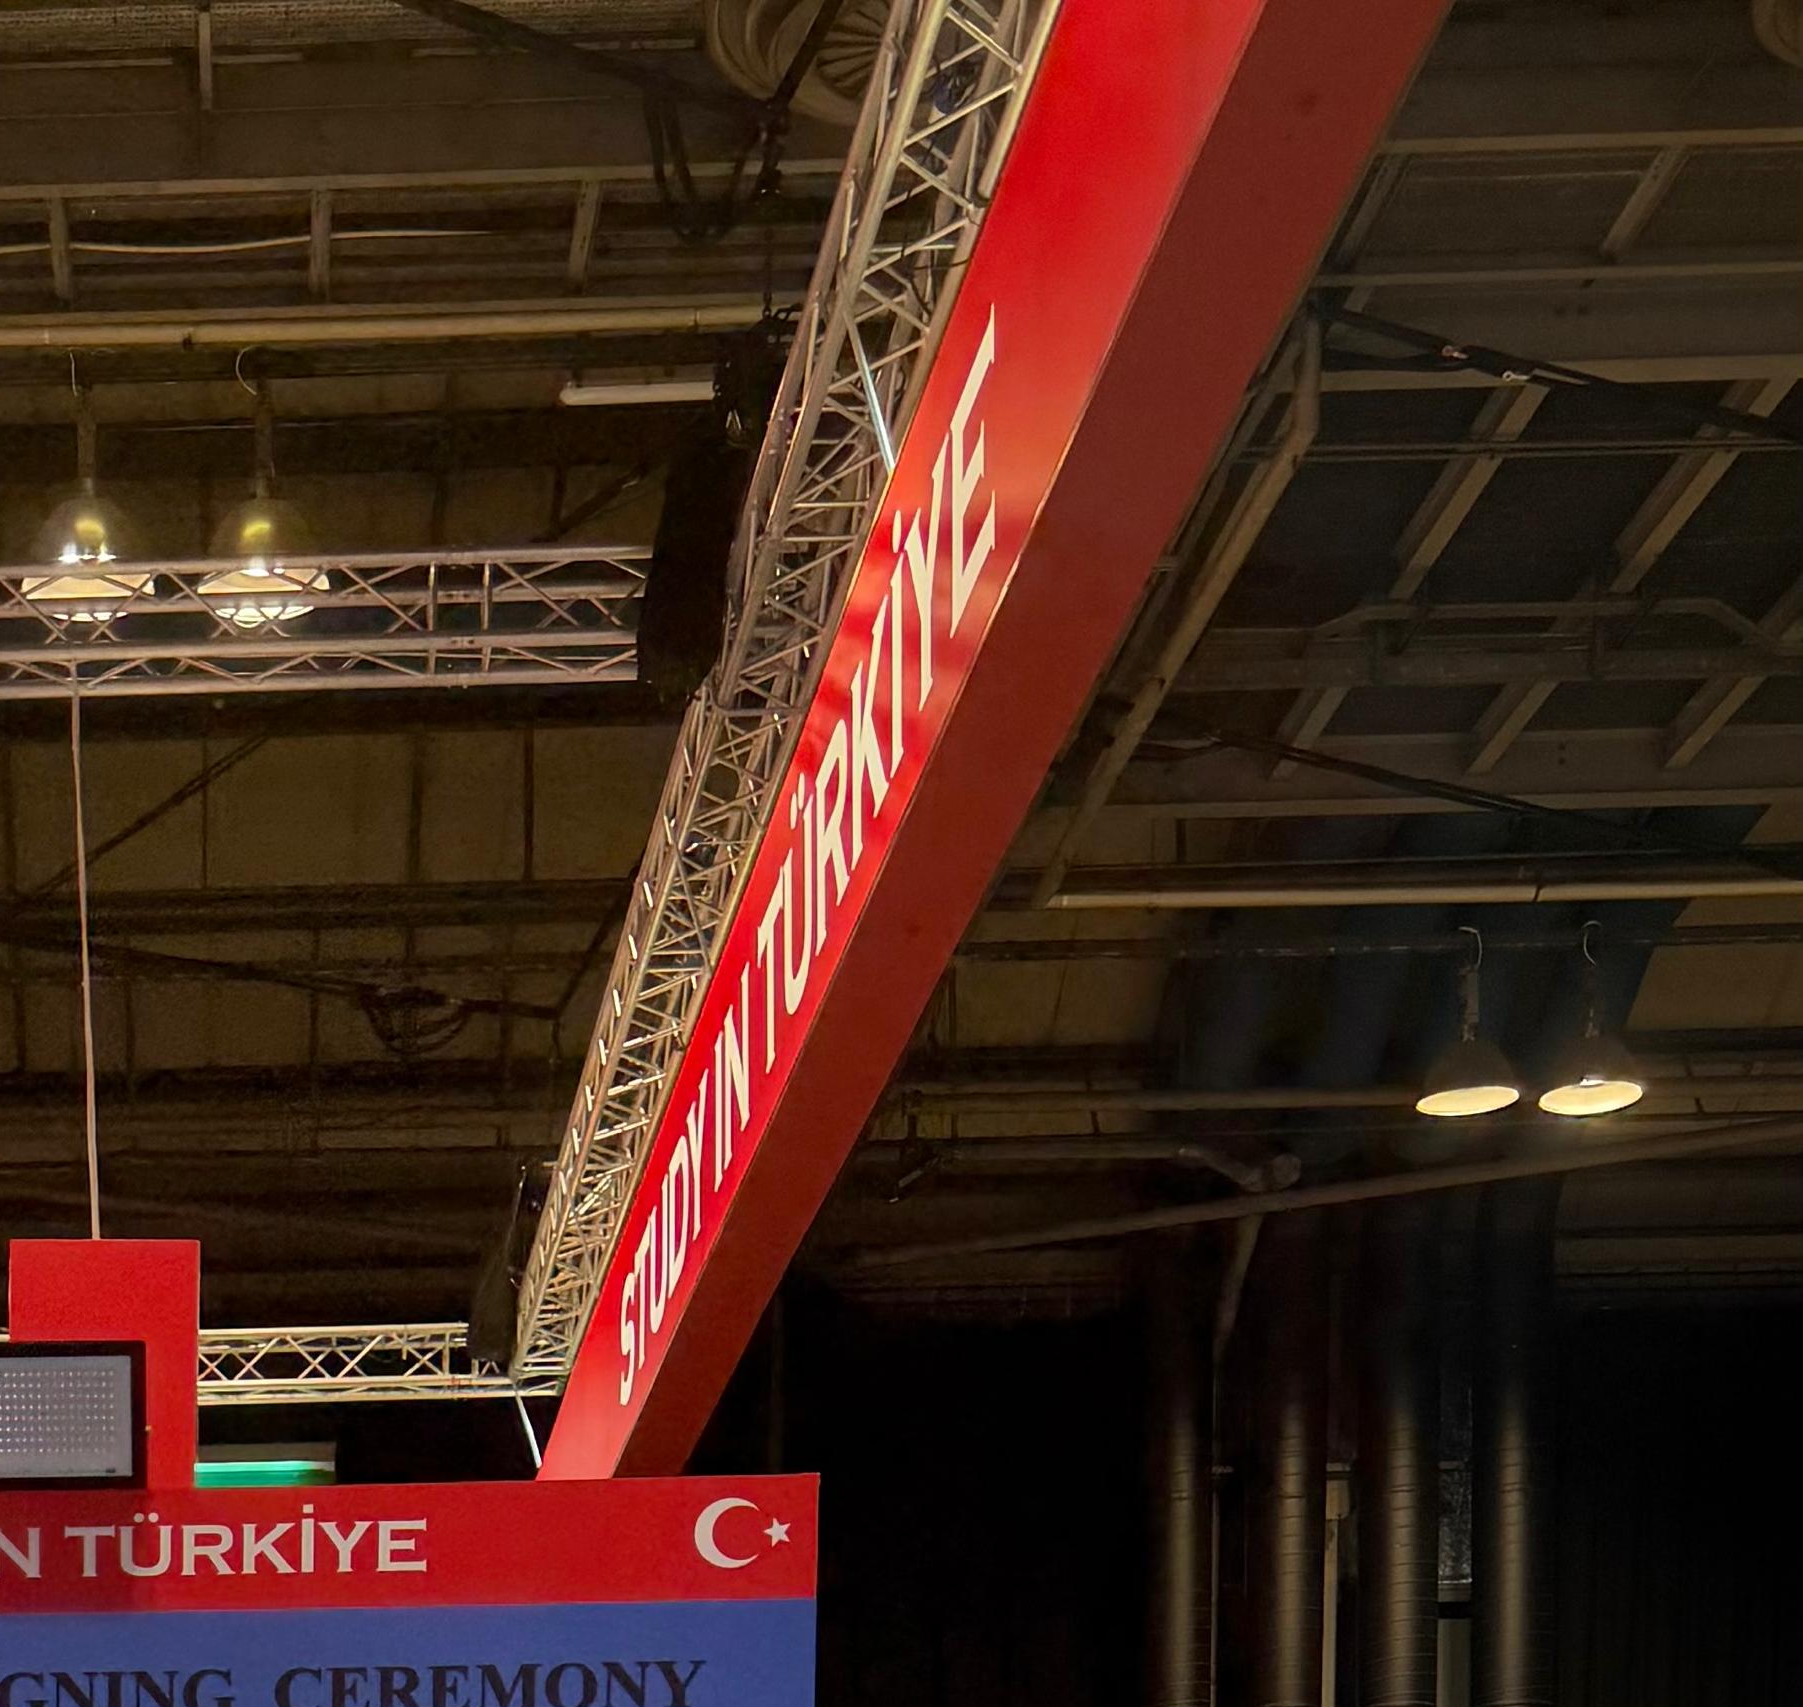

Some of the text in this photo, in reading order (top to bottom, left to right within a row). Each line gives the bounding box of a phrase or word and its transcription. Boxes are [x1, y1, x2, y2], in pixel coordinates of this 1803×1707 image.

[619, 303, 997, 1407] STUDY IN TÜRKİYE
[64, 1503, 428, 1578] TÜRKİYE
